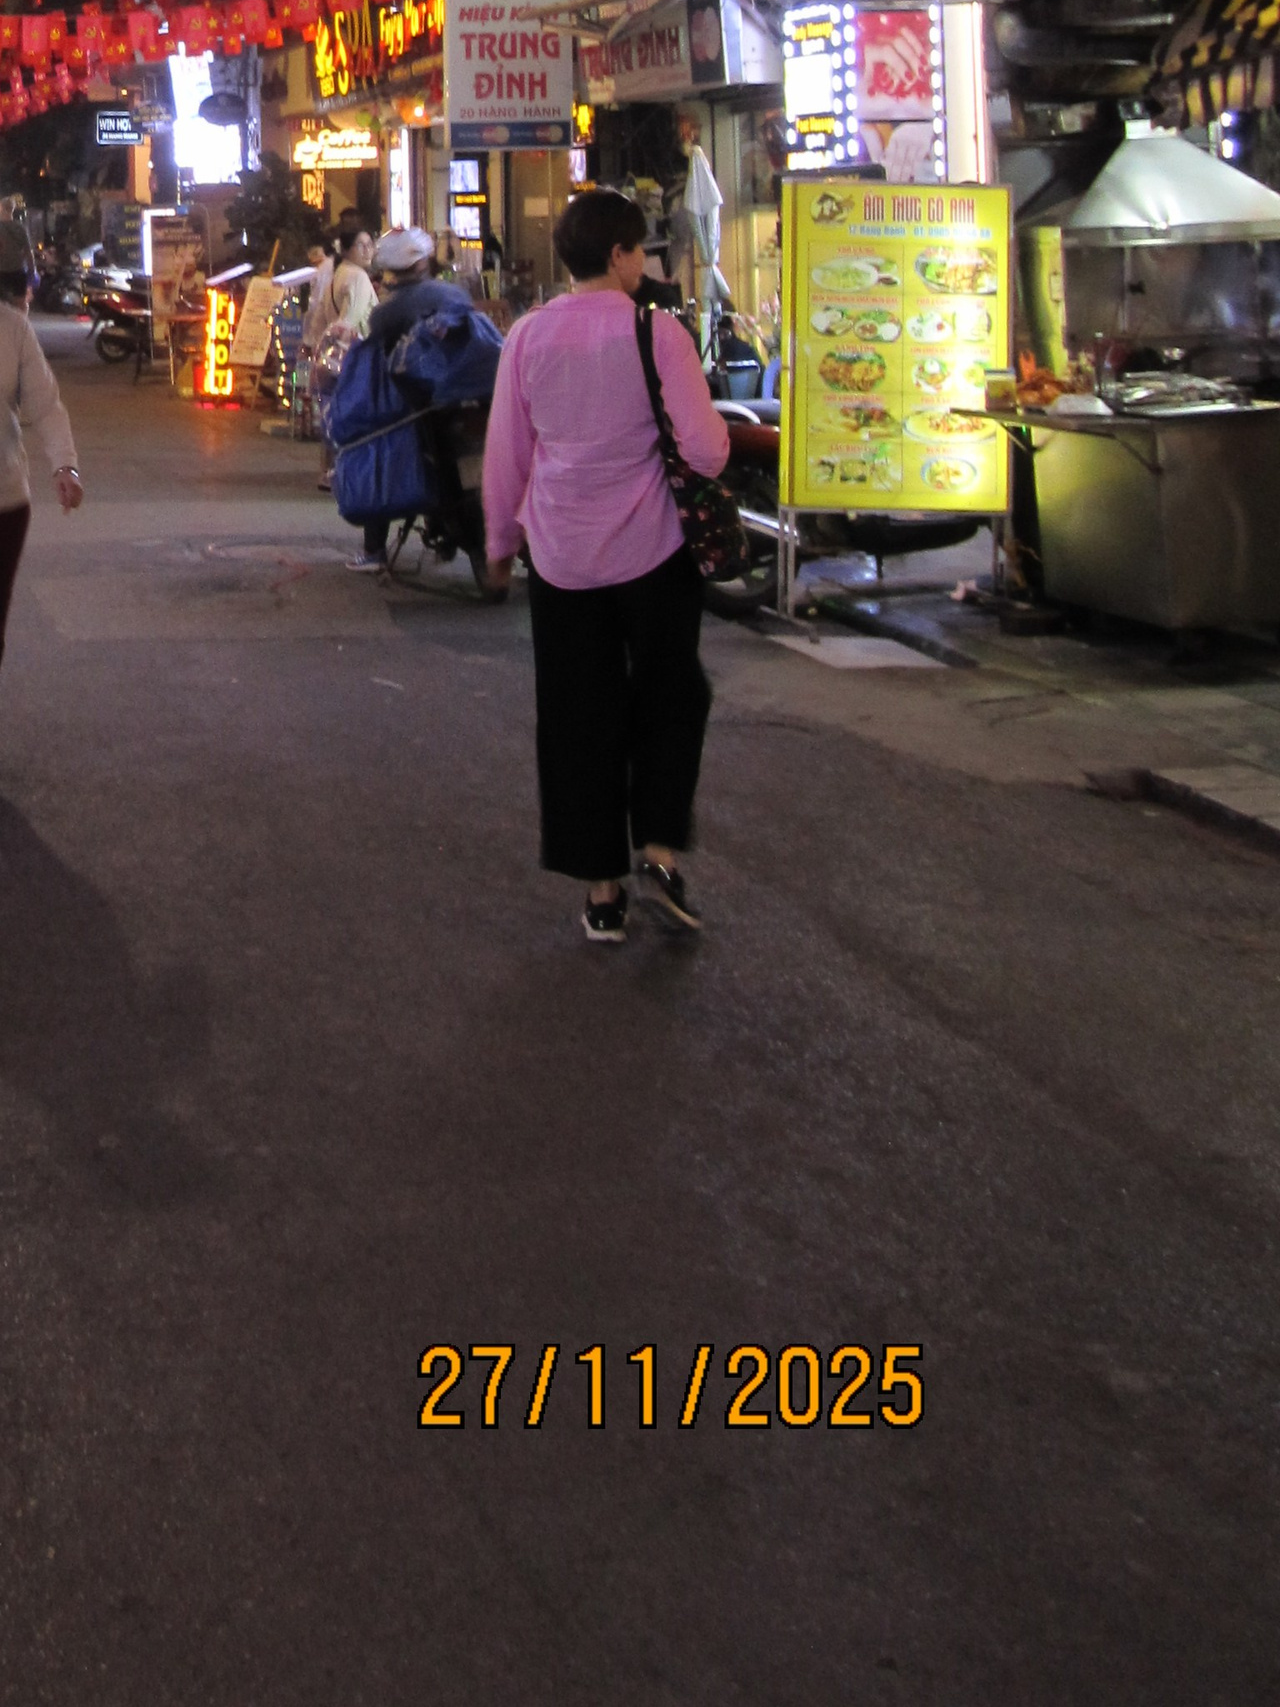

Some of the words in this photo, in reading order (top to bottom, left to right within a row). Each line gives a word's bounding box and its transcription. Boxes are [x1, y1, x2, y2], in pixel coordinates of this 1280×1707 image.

[459, 3, 506, 26] HIỆU
[460, 30, 561, 62] TRUNG
[217, 295, 230, 387] FOOT
